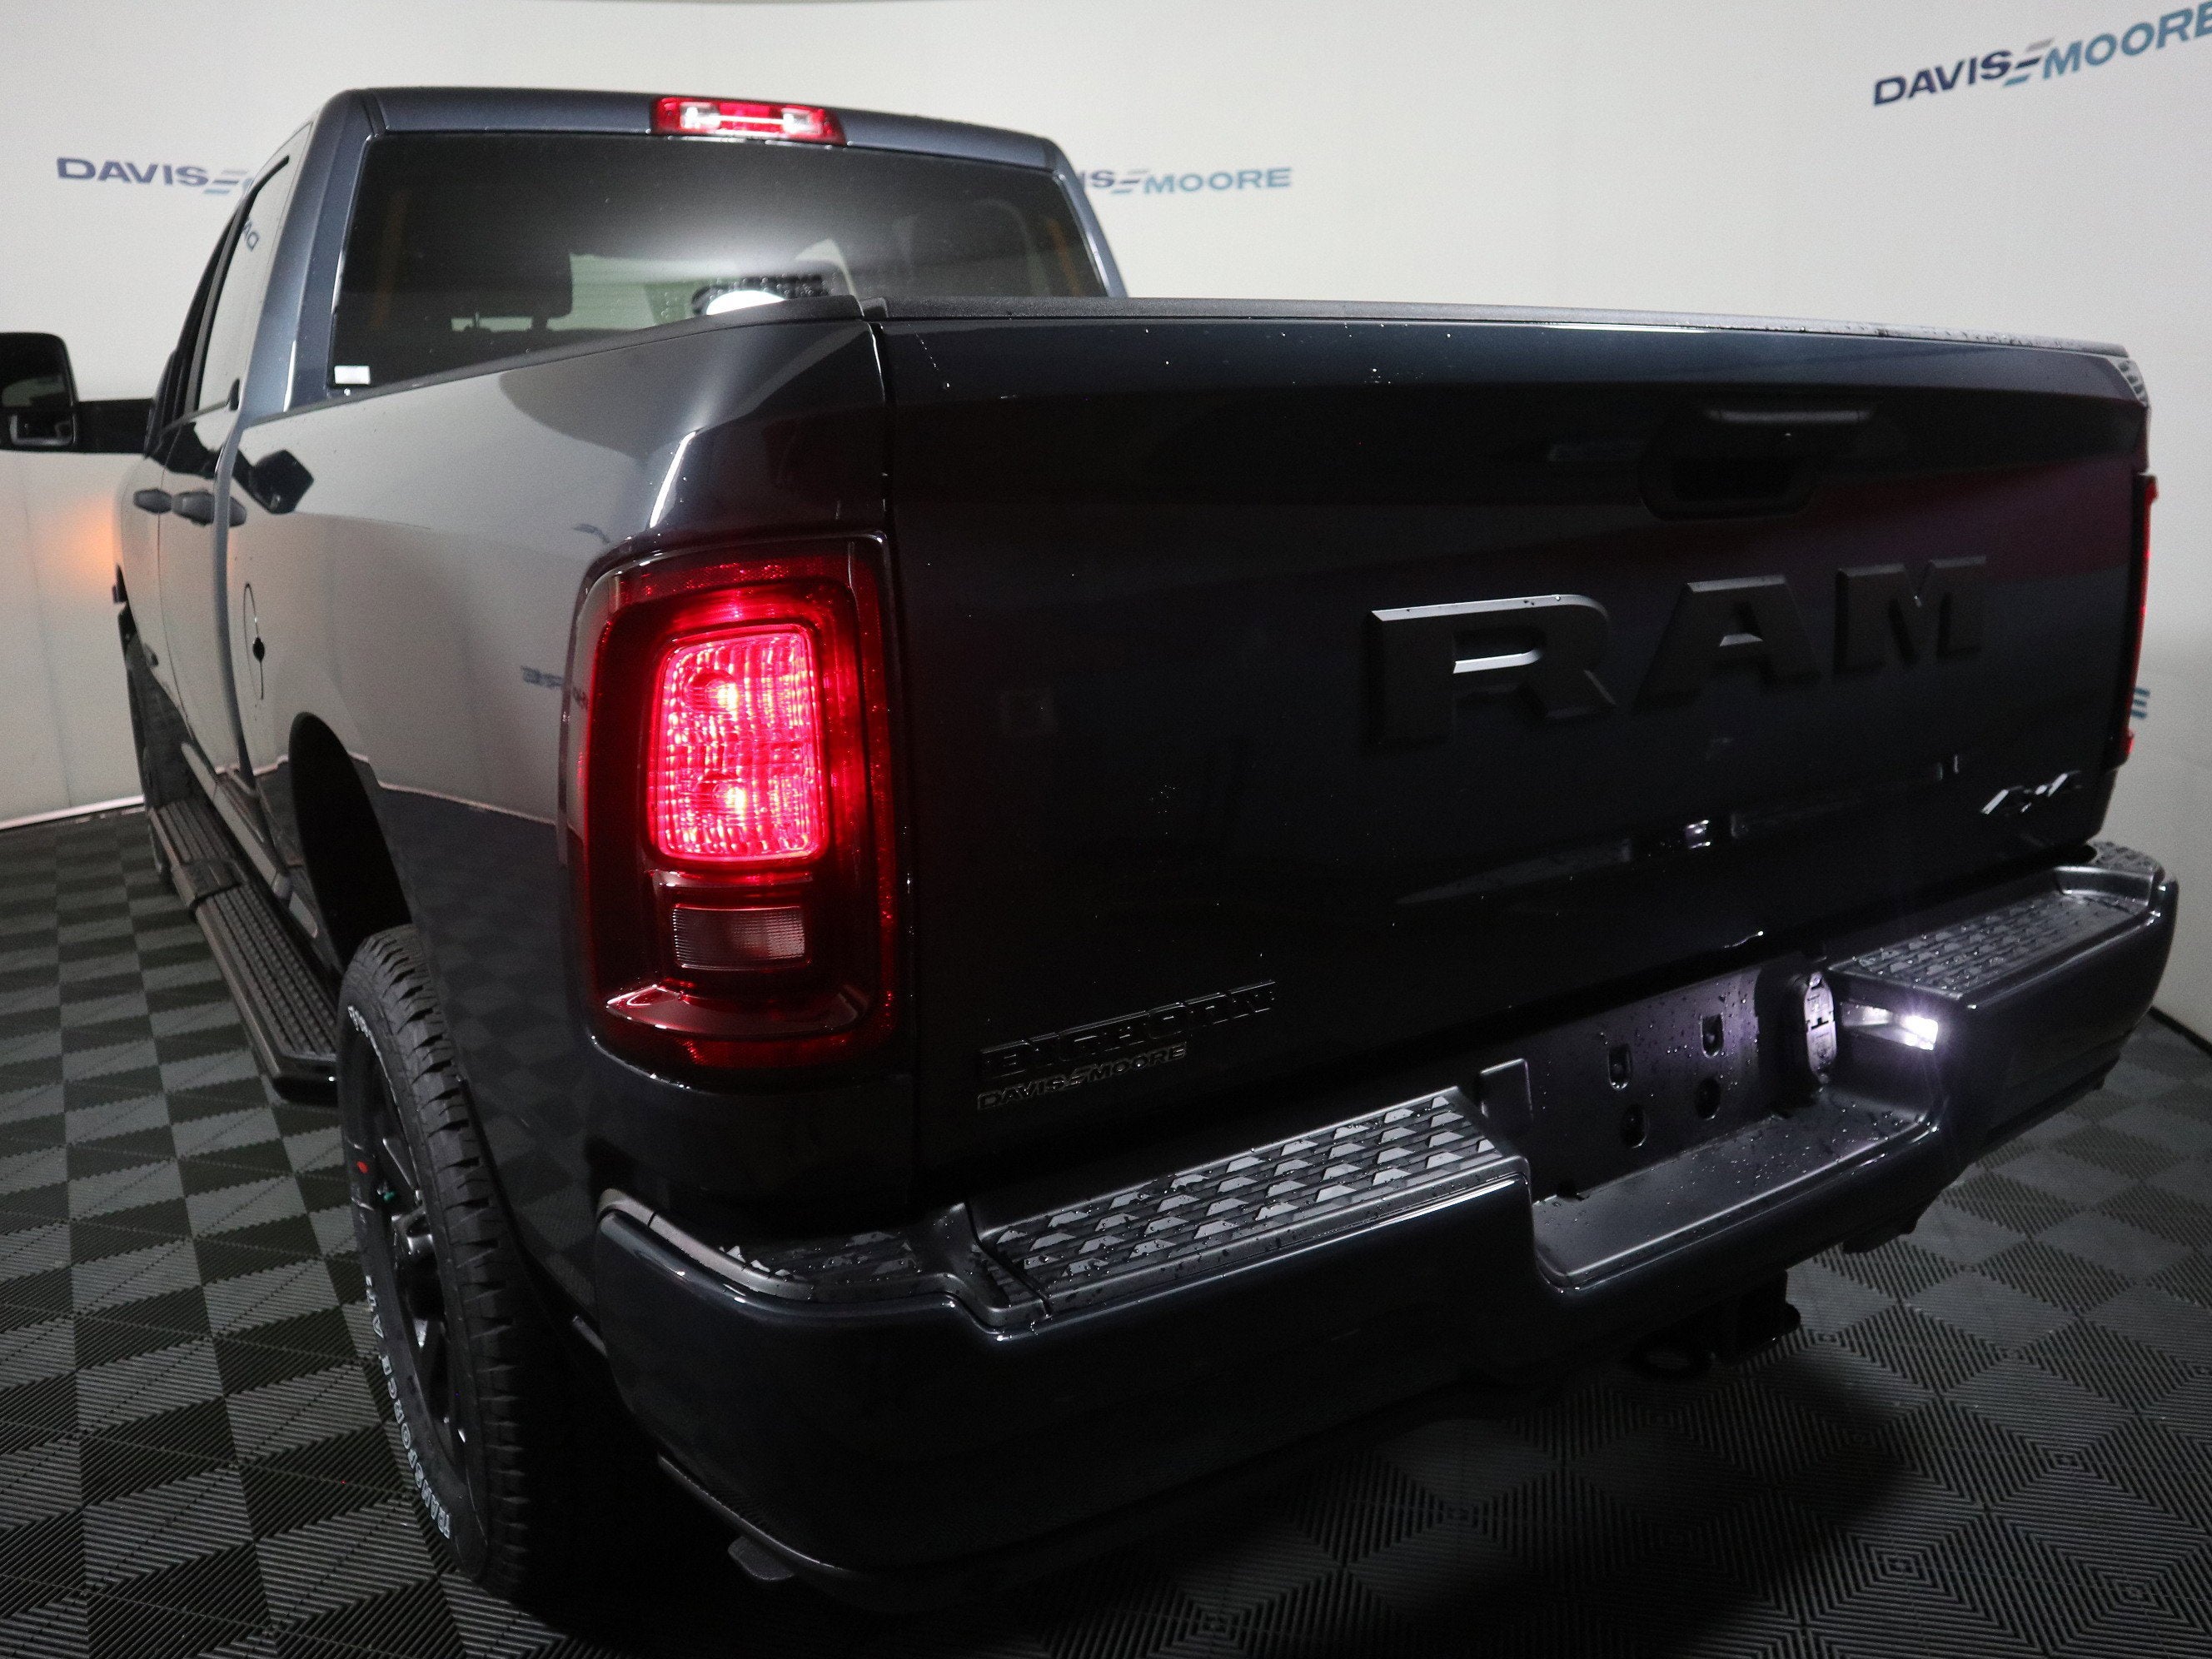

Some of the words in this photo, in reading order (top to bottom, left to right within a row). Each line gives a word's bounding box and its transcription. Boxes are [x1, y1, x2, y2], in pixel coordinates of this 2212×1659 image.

[1873, 49, 2014, 107] DAVIS
[56, 156, 209, 187] DAVIS
[1143, 167, 1293, 194] MOORE
[1364, 555, 1987, 750] RAM
